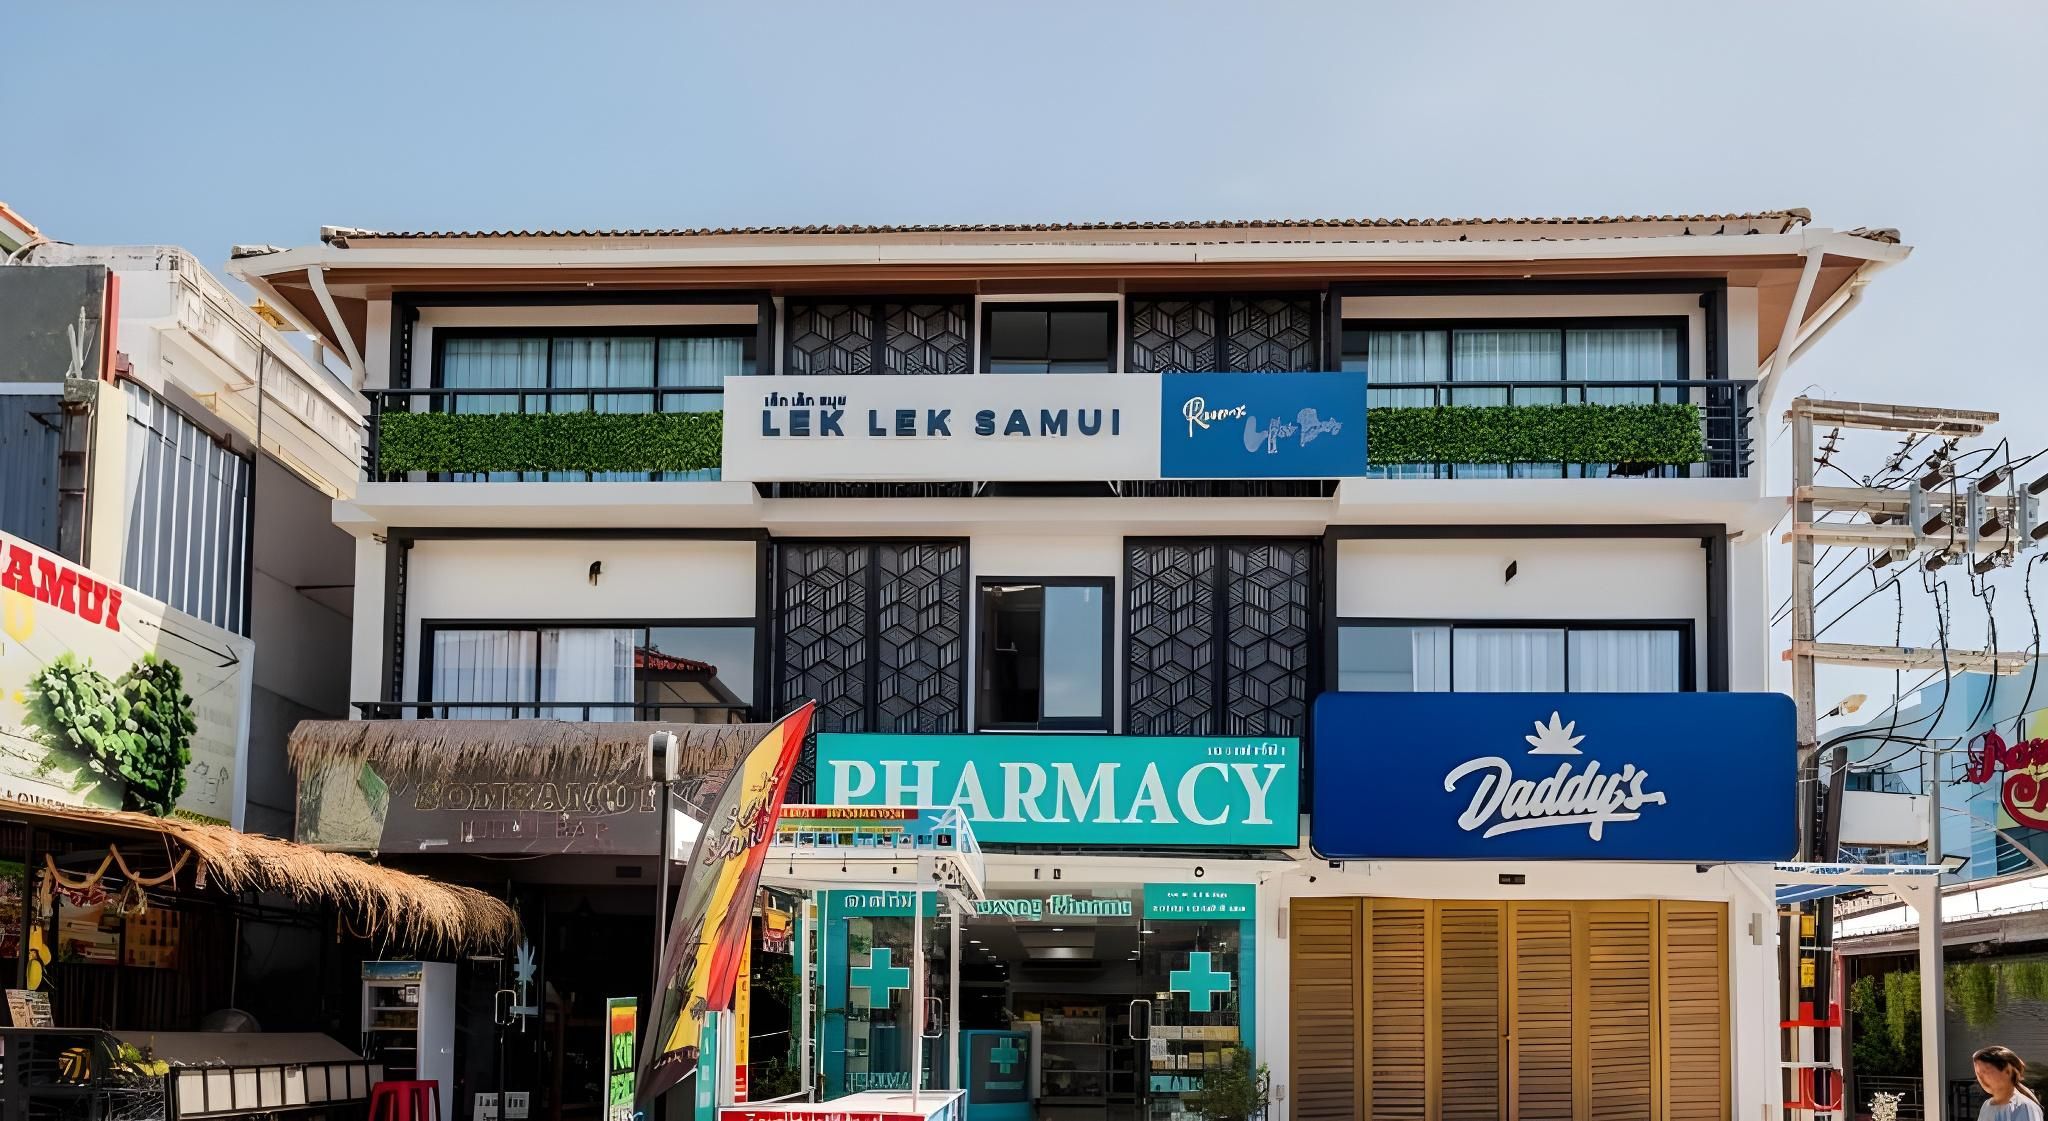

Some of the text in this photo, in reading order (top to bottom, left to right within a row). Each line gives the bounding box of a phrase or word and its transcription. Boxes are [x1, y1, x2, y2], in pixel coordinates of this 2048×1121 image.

[762, 408, 1120, 437] LEK LEK SAMUI
[0, 538, 123, 633] AMUI
[828, 759, 1286, 826] PHARMACY
[1444, 756, 1667, 841] Daddy's
